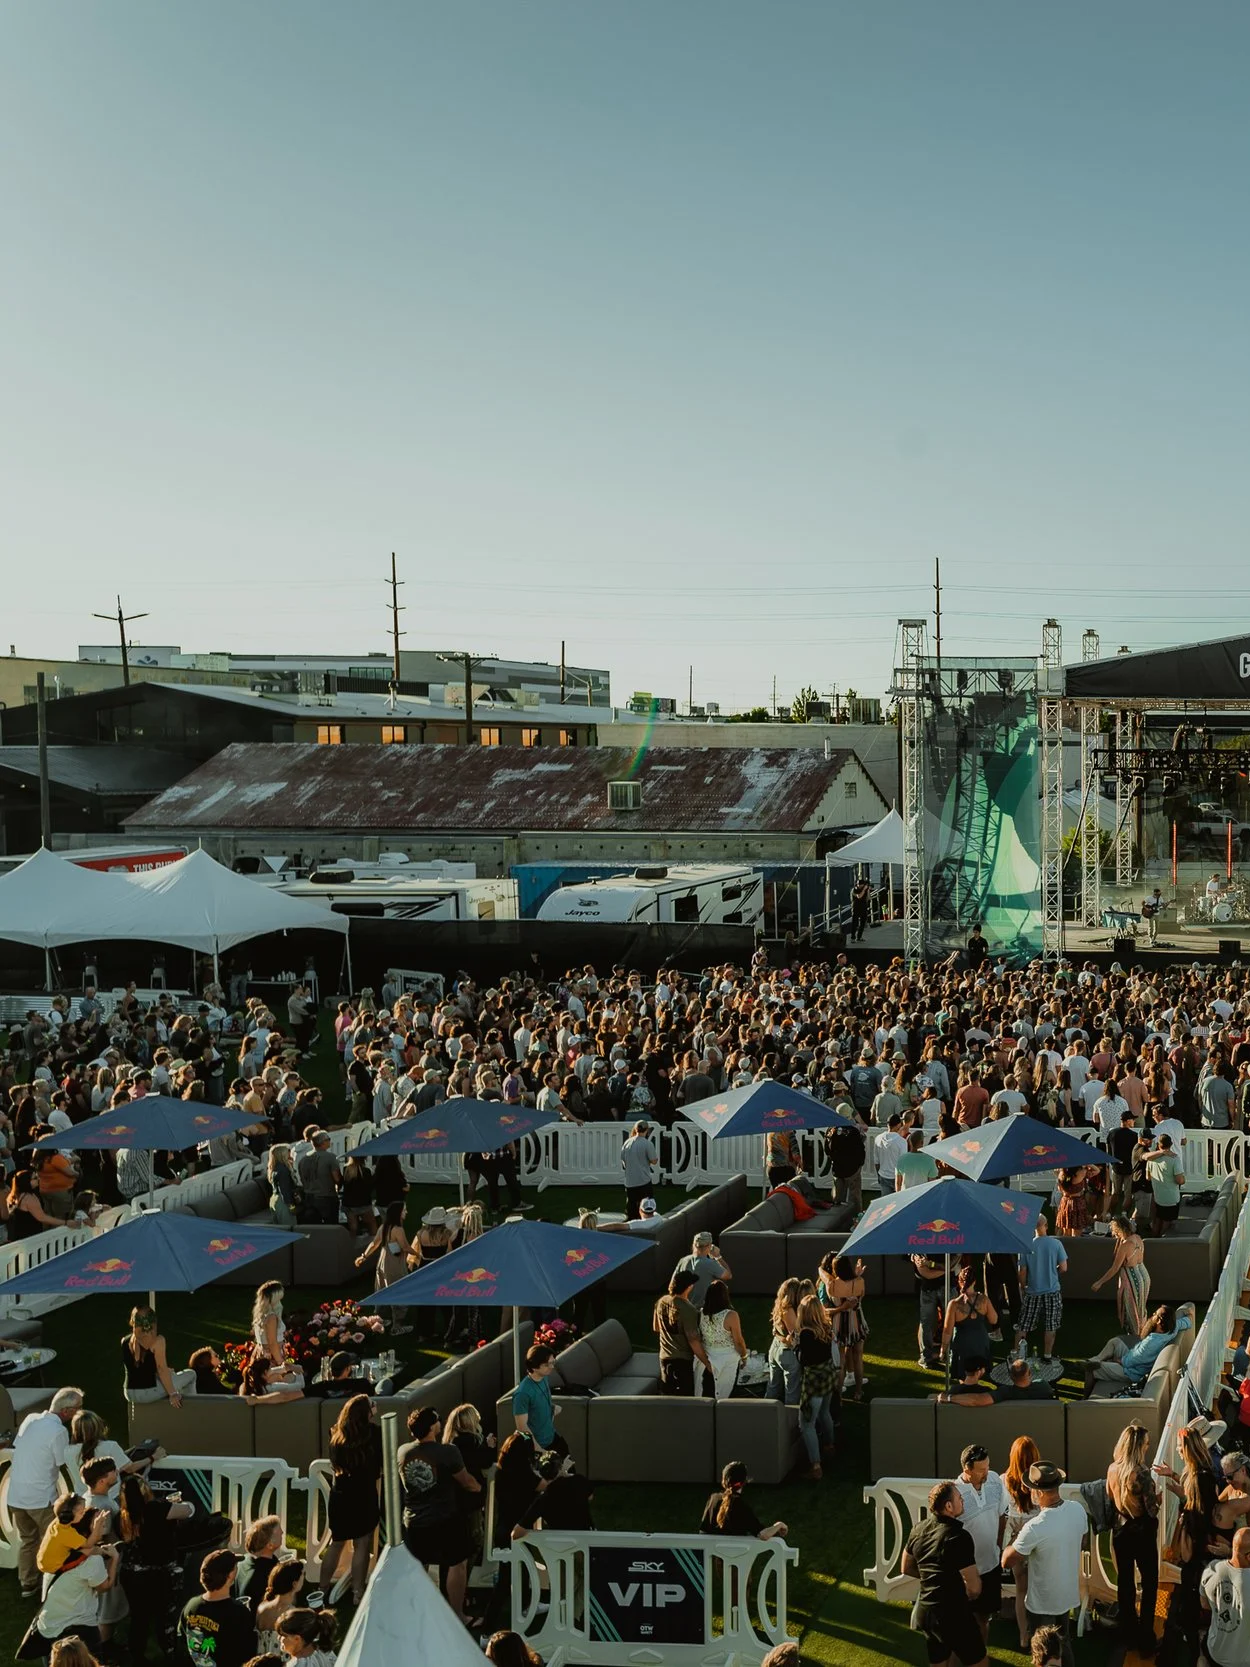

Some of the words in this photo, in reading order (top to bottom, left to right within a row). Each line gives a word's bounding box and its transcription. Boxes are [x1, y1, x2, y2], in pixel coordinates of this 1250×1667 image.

[565, 909, 600, 917] Jayco
[908, 1233, 936, 1245] Red
[937, 1233, 965, 1245] Bull
[64, 1274, 100, 1287] Red
[98, 1273, 132, 1287] Bull
[434, 1284, 467, 1297] Red
[465, 1284, 498, 1297] Bull
[150, 1480, 177, 1490] SKY
[628, 1561, 664, 1572] SKY
[607, 1582, 686, 1608] VIP
